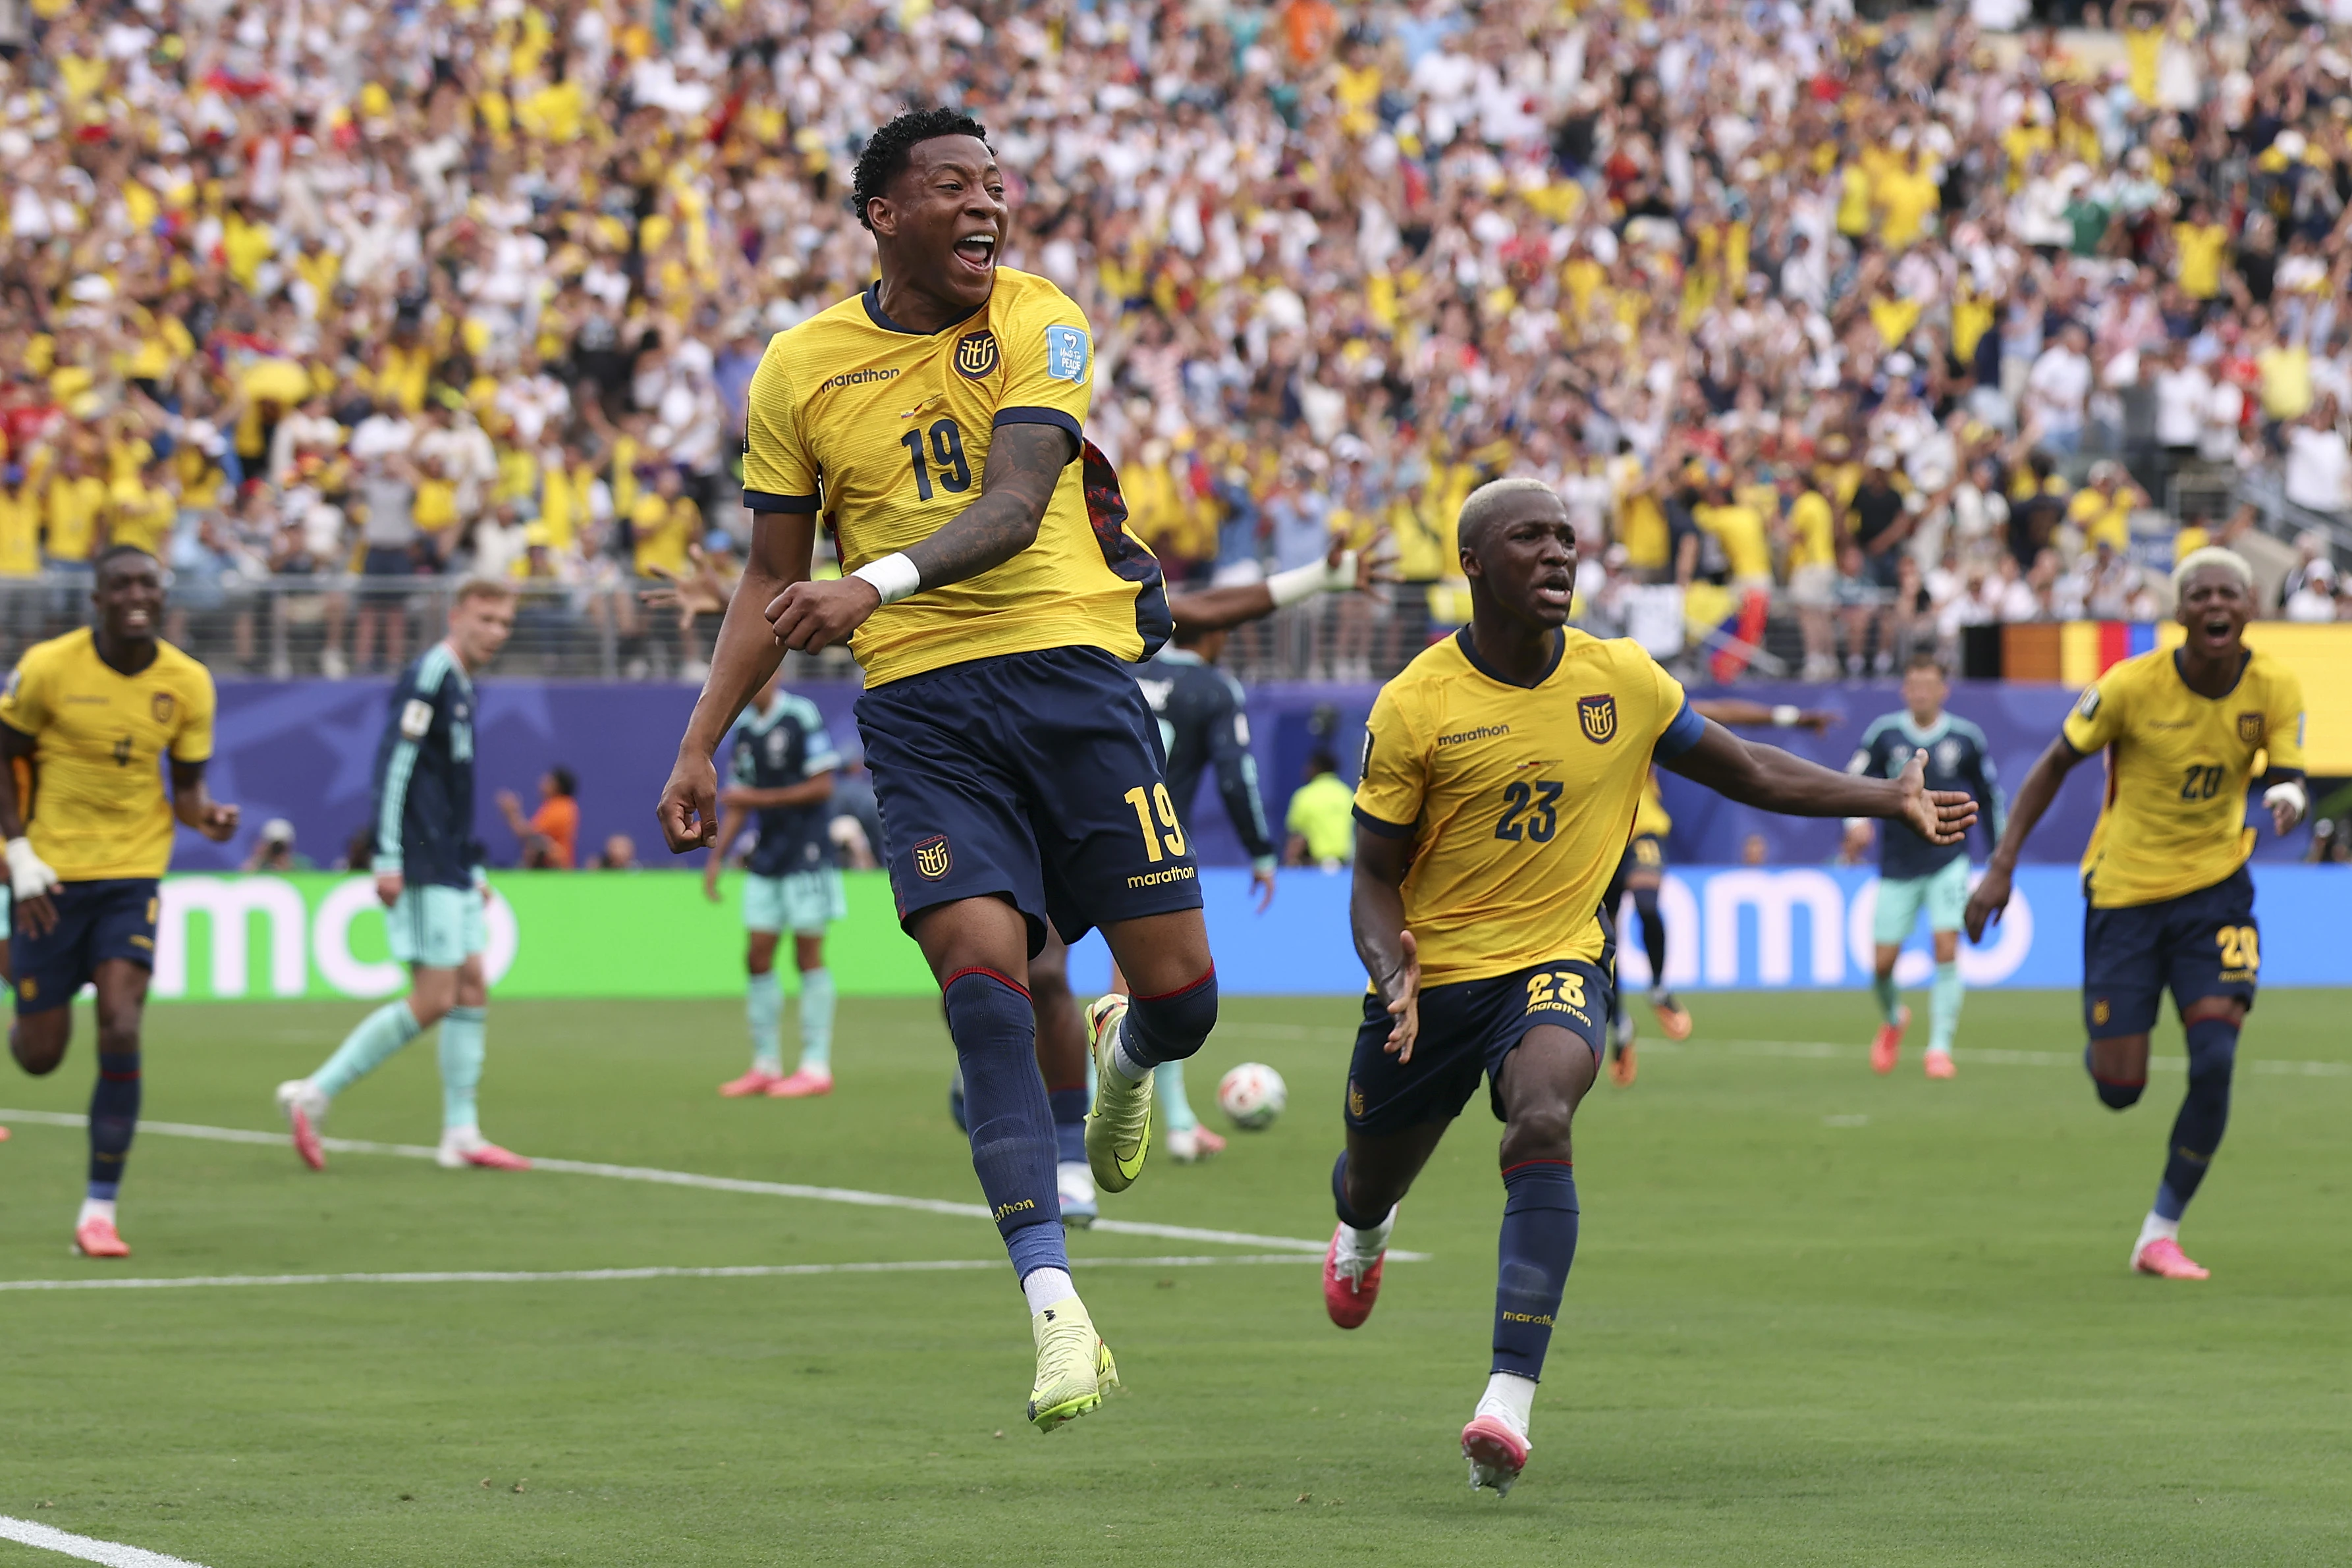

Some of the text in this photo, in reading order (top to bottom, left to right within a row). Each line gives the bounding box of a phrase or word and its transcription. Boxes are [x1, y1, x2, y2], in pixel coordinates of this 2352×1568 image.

[821, 368, 900, 393] marathon
[1061, 357, 1081, 370] PEACE
[900, 418, 971, 502] 19
[1438, 724, 1510, 746] marathon
[2181, 764, 2224, 800] 20
[1124, 782, 1187, 863] 19
[1494, 780, 1564, 843] 23
[1127, 866, 1195, 888] marathon
[155, 875, 519, 998] mc
[1527, 971, 1587, 1008] 23
[1525, 1001, 1591, 1027] marathon
